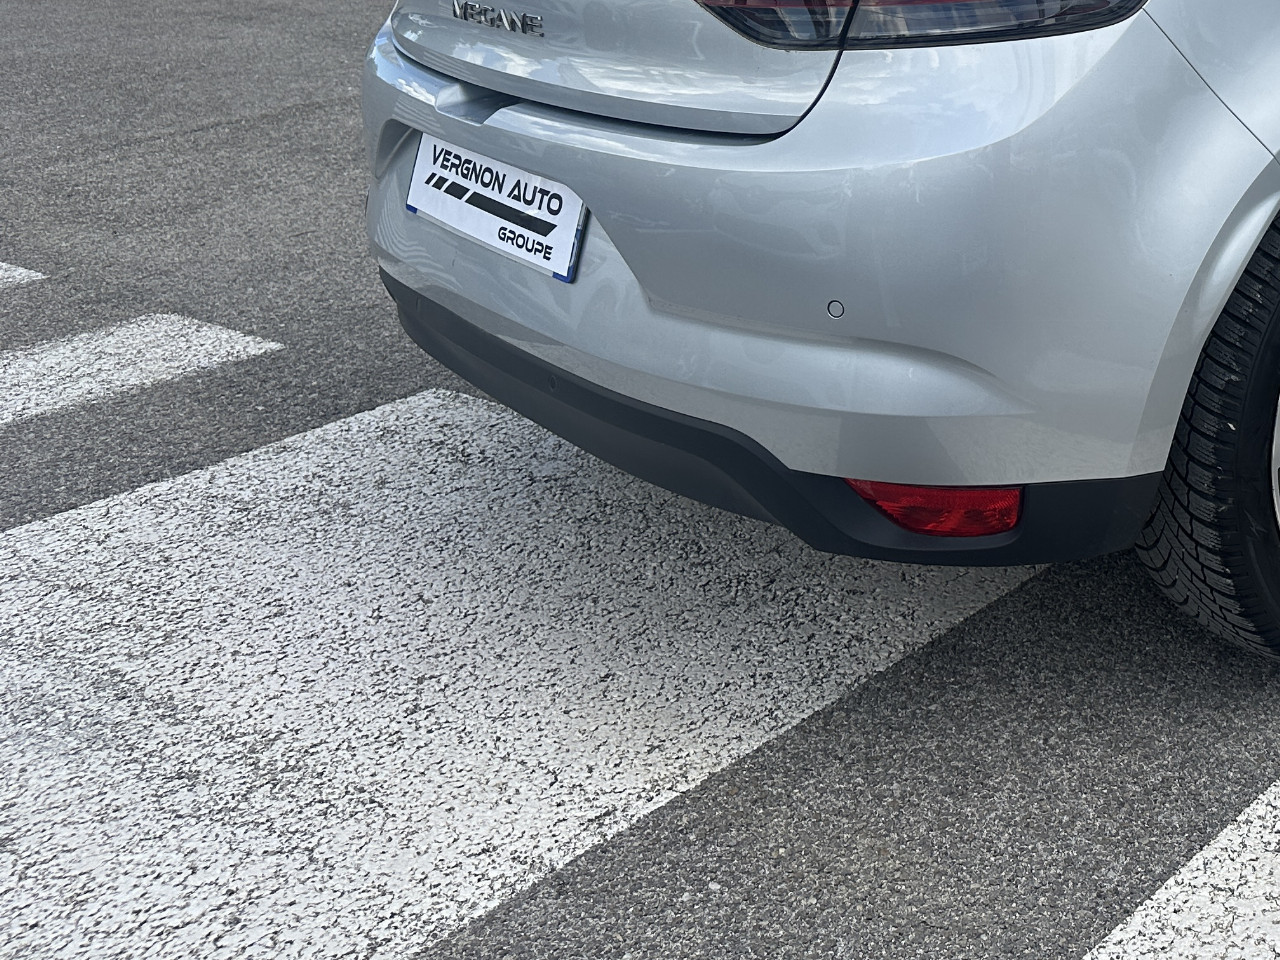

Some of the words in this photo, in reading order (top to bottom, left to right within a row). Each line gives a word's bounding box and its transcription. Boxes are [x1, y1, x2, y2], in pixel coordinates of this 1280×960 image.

[432, 143, 507, 195] VERGNON
[507, 179, 563, 216] AUTO
[497, 226, 554, 261] GROUPE
